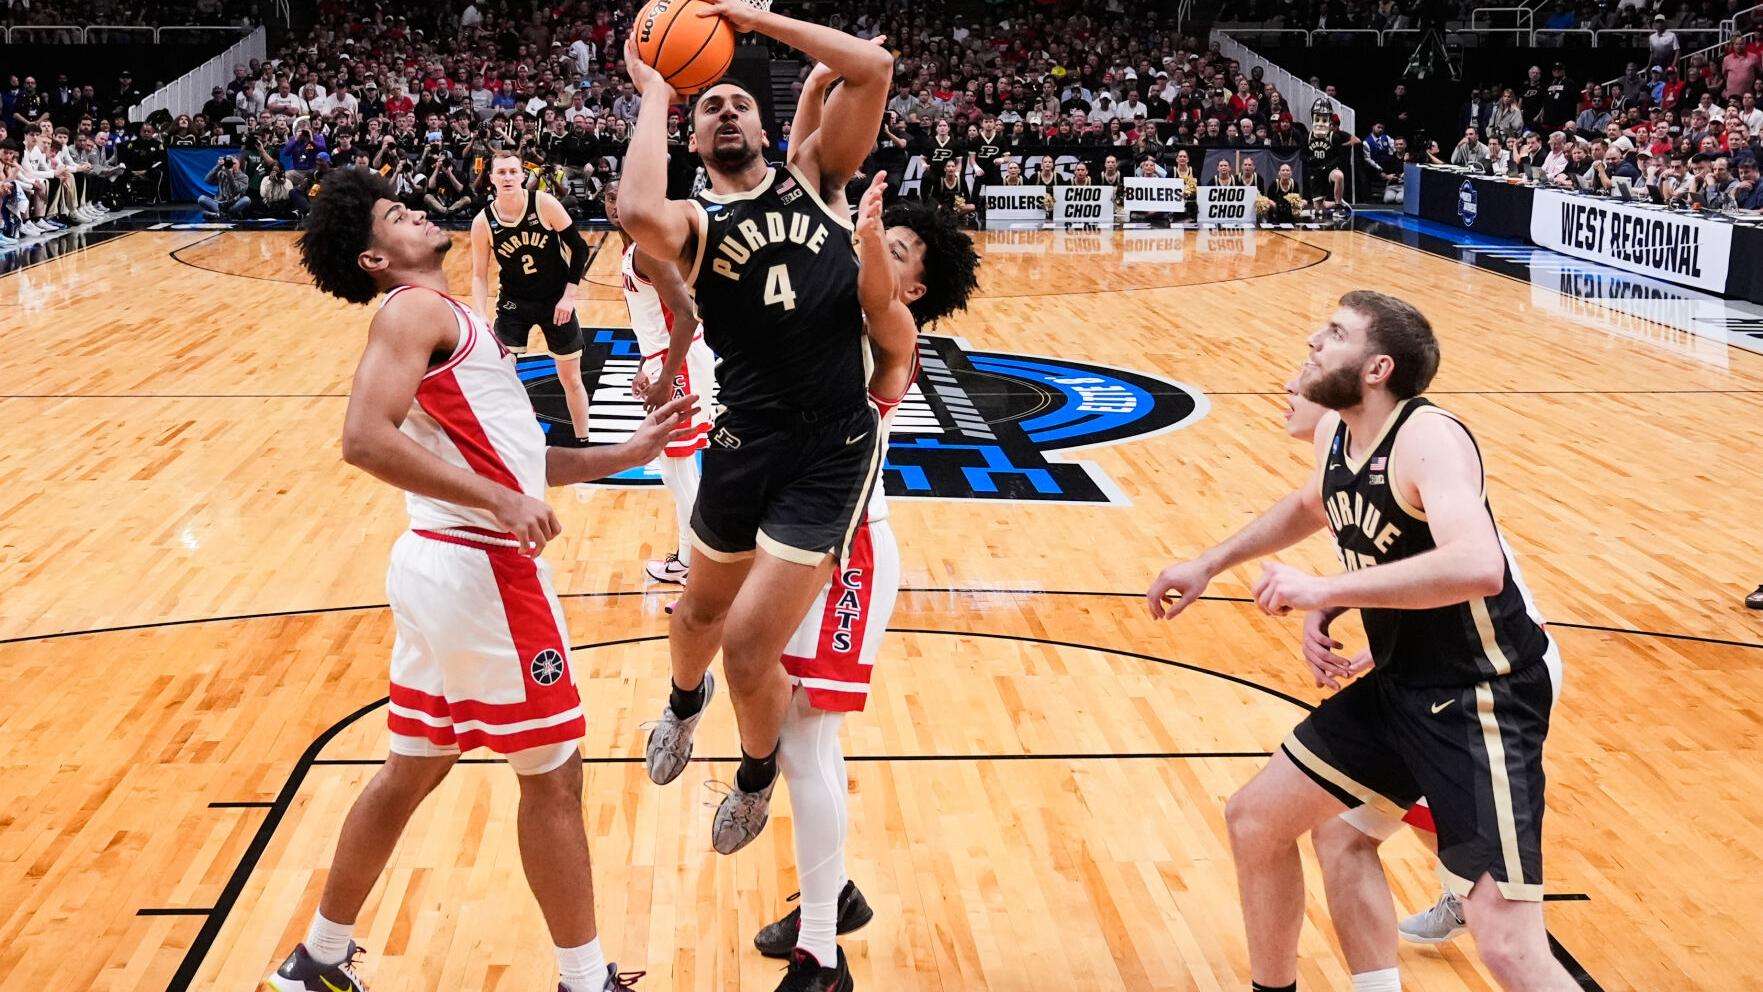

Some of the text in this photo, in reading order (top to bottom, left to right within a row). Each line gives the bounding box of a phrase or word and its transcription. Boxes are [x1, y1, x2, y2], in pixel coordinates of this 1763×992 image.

[932, 149, 953, 162] P
[978, 145, 1000, 159] P
[1064, 187, 1102, 202] CHOO
[1125, 187, 1183, 202] BOILERS
[1208, 188, 1245, 202] CHOO
[987, 195, 1046, 210] BOILERS
[1064, 204, 1102, 218] CHOO
[1208, 204, 1245, 219] CHOO
[498, 231, 549, 259] PURDUE
[713, 211, 829, 281] PURDUE
[1561, 201, 1702, 278] WEST REGIONAL
[521, 254, 538, 275] 2
[764, 263, 797, 311] 4
[1326, 490, 1402, 555] URDUE
[832, 568, 863, 653] CATS
